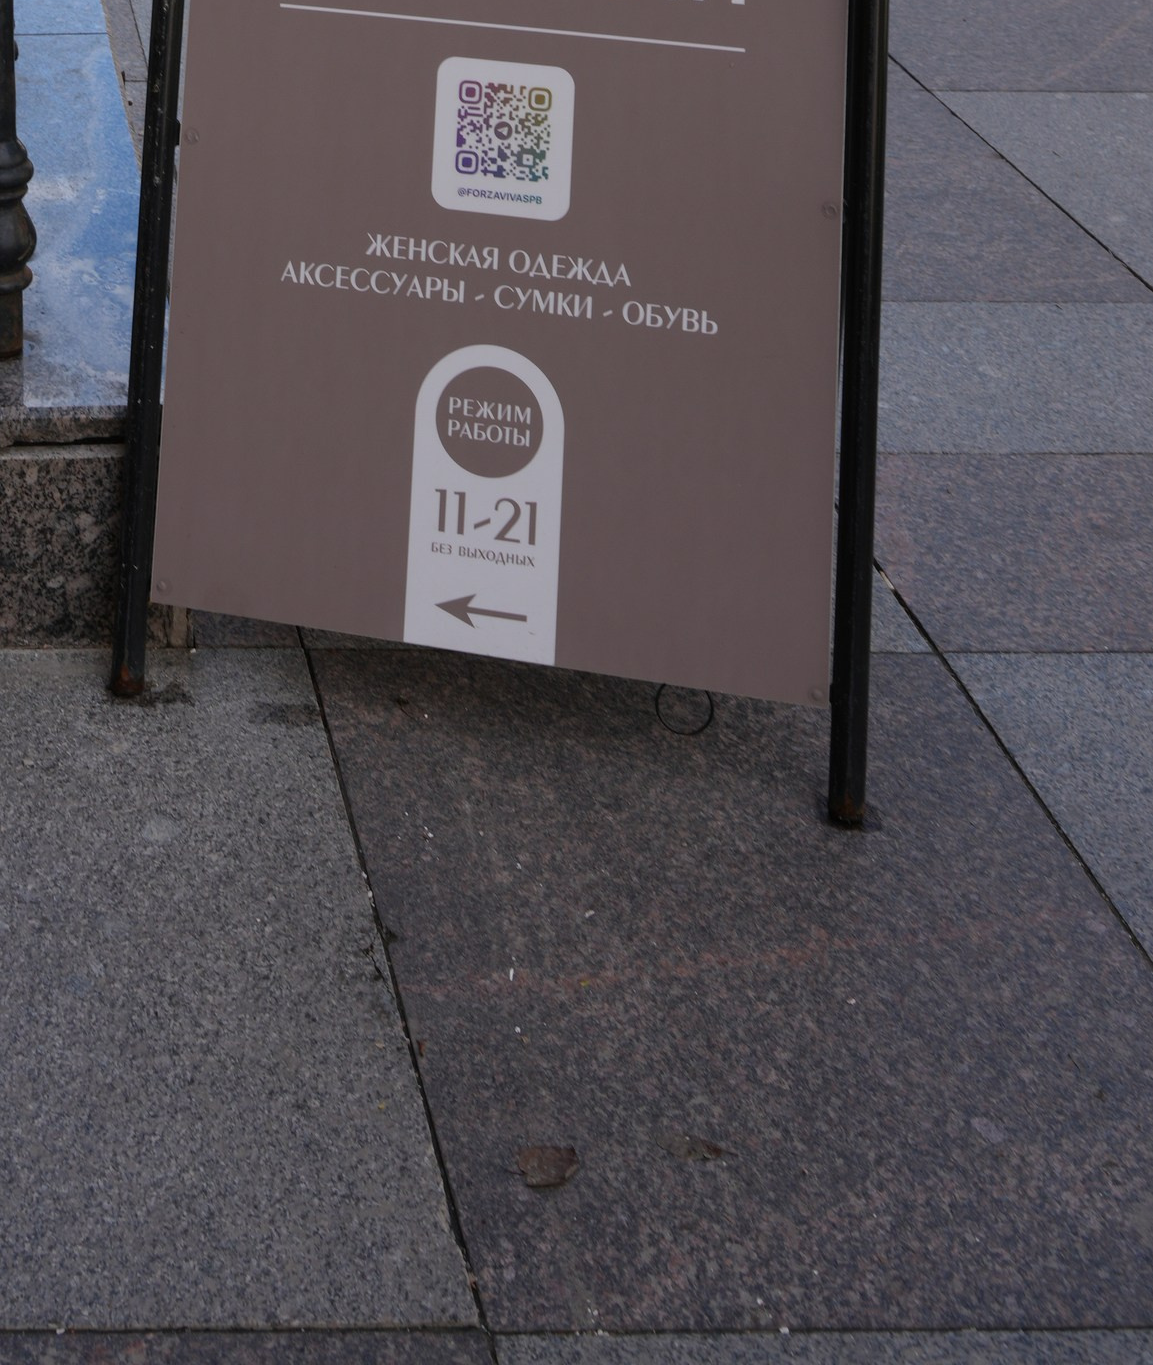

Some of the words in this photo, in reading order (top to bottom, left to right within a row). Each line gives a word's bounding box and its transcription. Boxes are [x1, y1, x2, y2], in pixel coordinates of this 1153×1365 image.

[457, 187, 543, 205] @FORZAVIVASPB
[365, 232, 499, 271] ЖЕНСКАЯ
[508, 249, 632, 288] ОДЕЖДА
[280, 260, 465, 304] АКСЕССУАРЫ
[493, 284, 593, 320] СУМКИ
[622, 300, 719, 335] ОБУВЬ
[448, 396, 532, 425] РЕЖИМ
[447, 419, 531, 448] РАБОТЫ
[434, 488, 538, 546] 11-21
[431, 542, 453, 555] БЕЗ
[458, 545, 535, 568] ВЫХОДНЫХ
